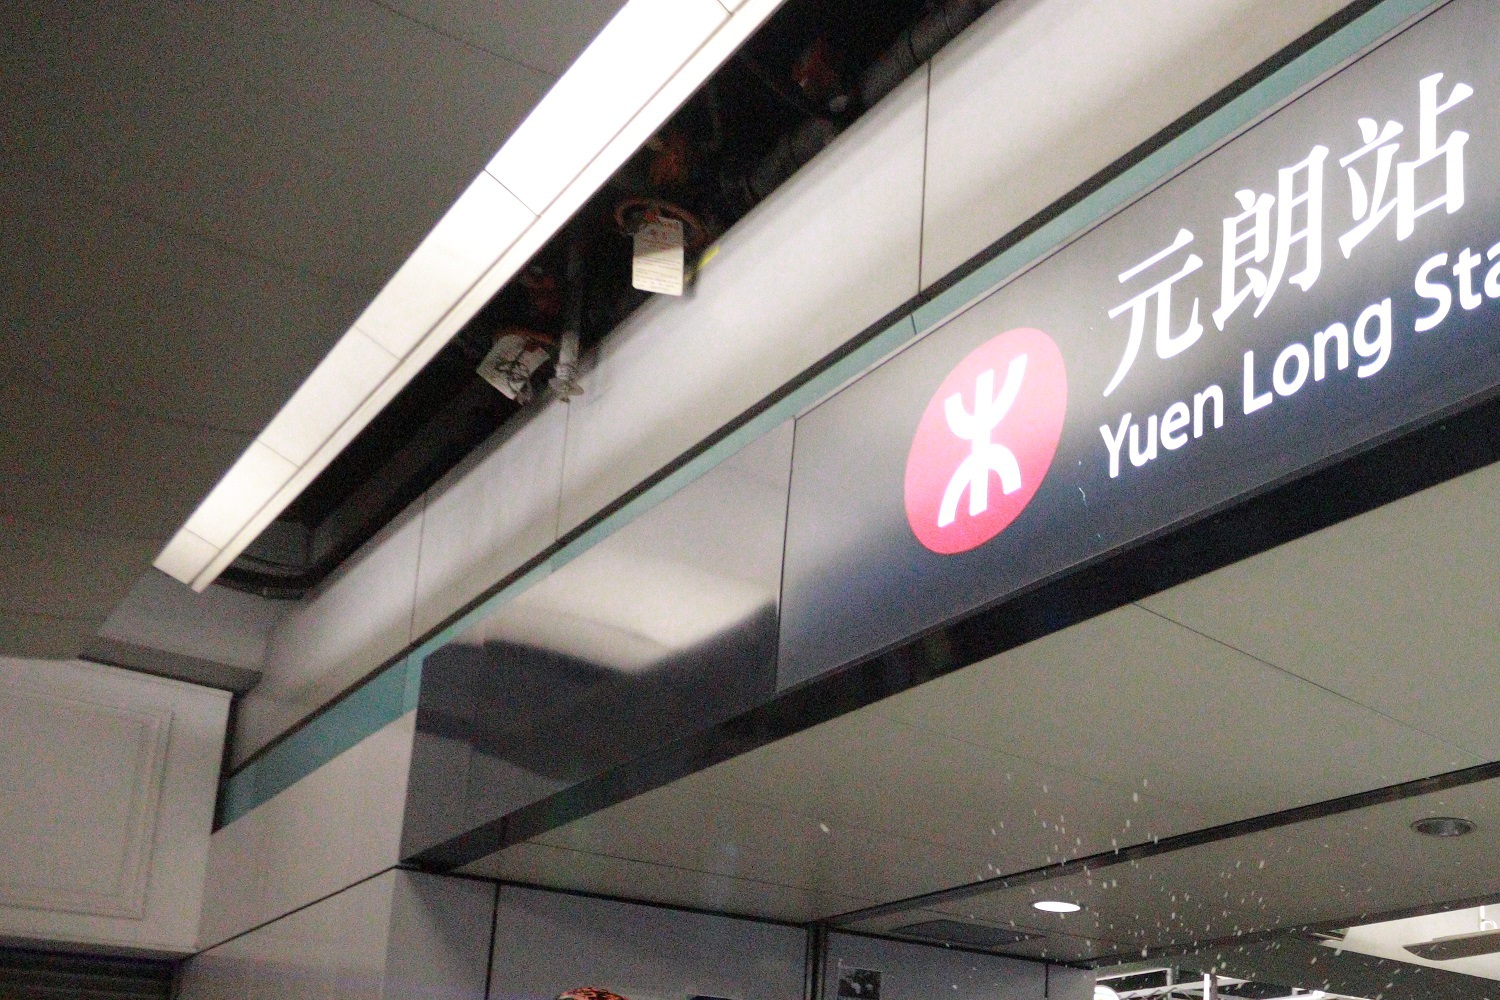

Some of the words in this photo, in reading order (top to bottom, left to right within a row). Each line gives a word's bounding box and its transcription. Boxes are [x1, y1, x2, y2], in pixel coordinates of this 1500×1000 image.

[1102, 72, 1474, 398] 元朗站
[1100, 385, 1224, 479] Yuen
[1243, 298, 1392, 415] Long
